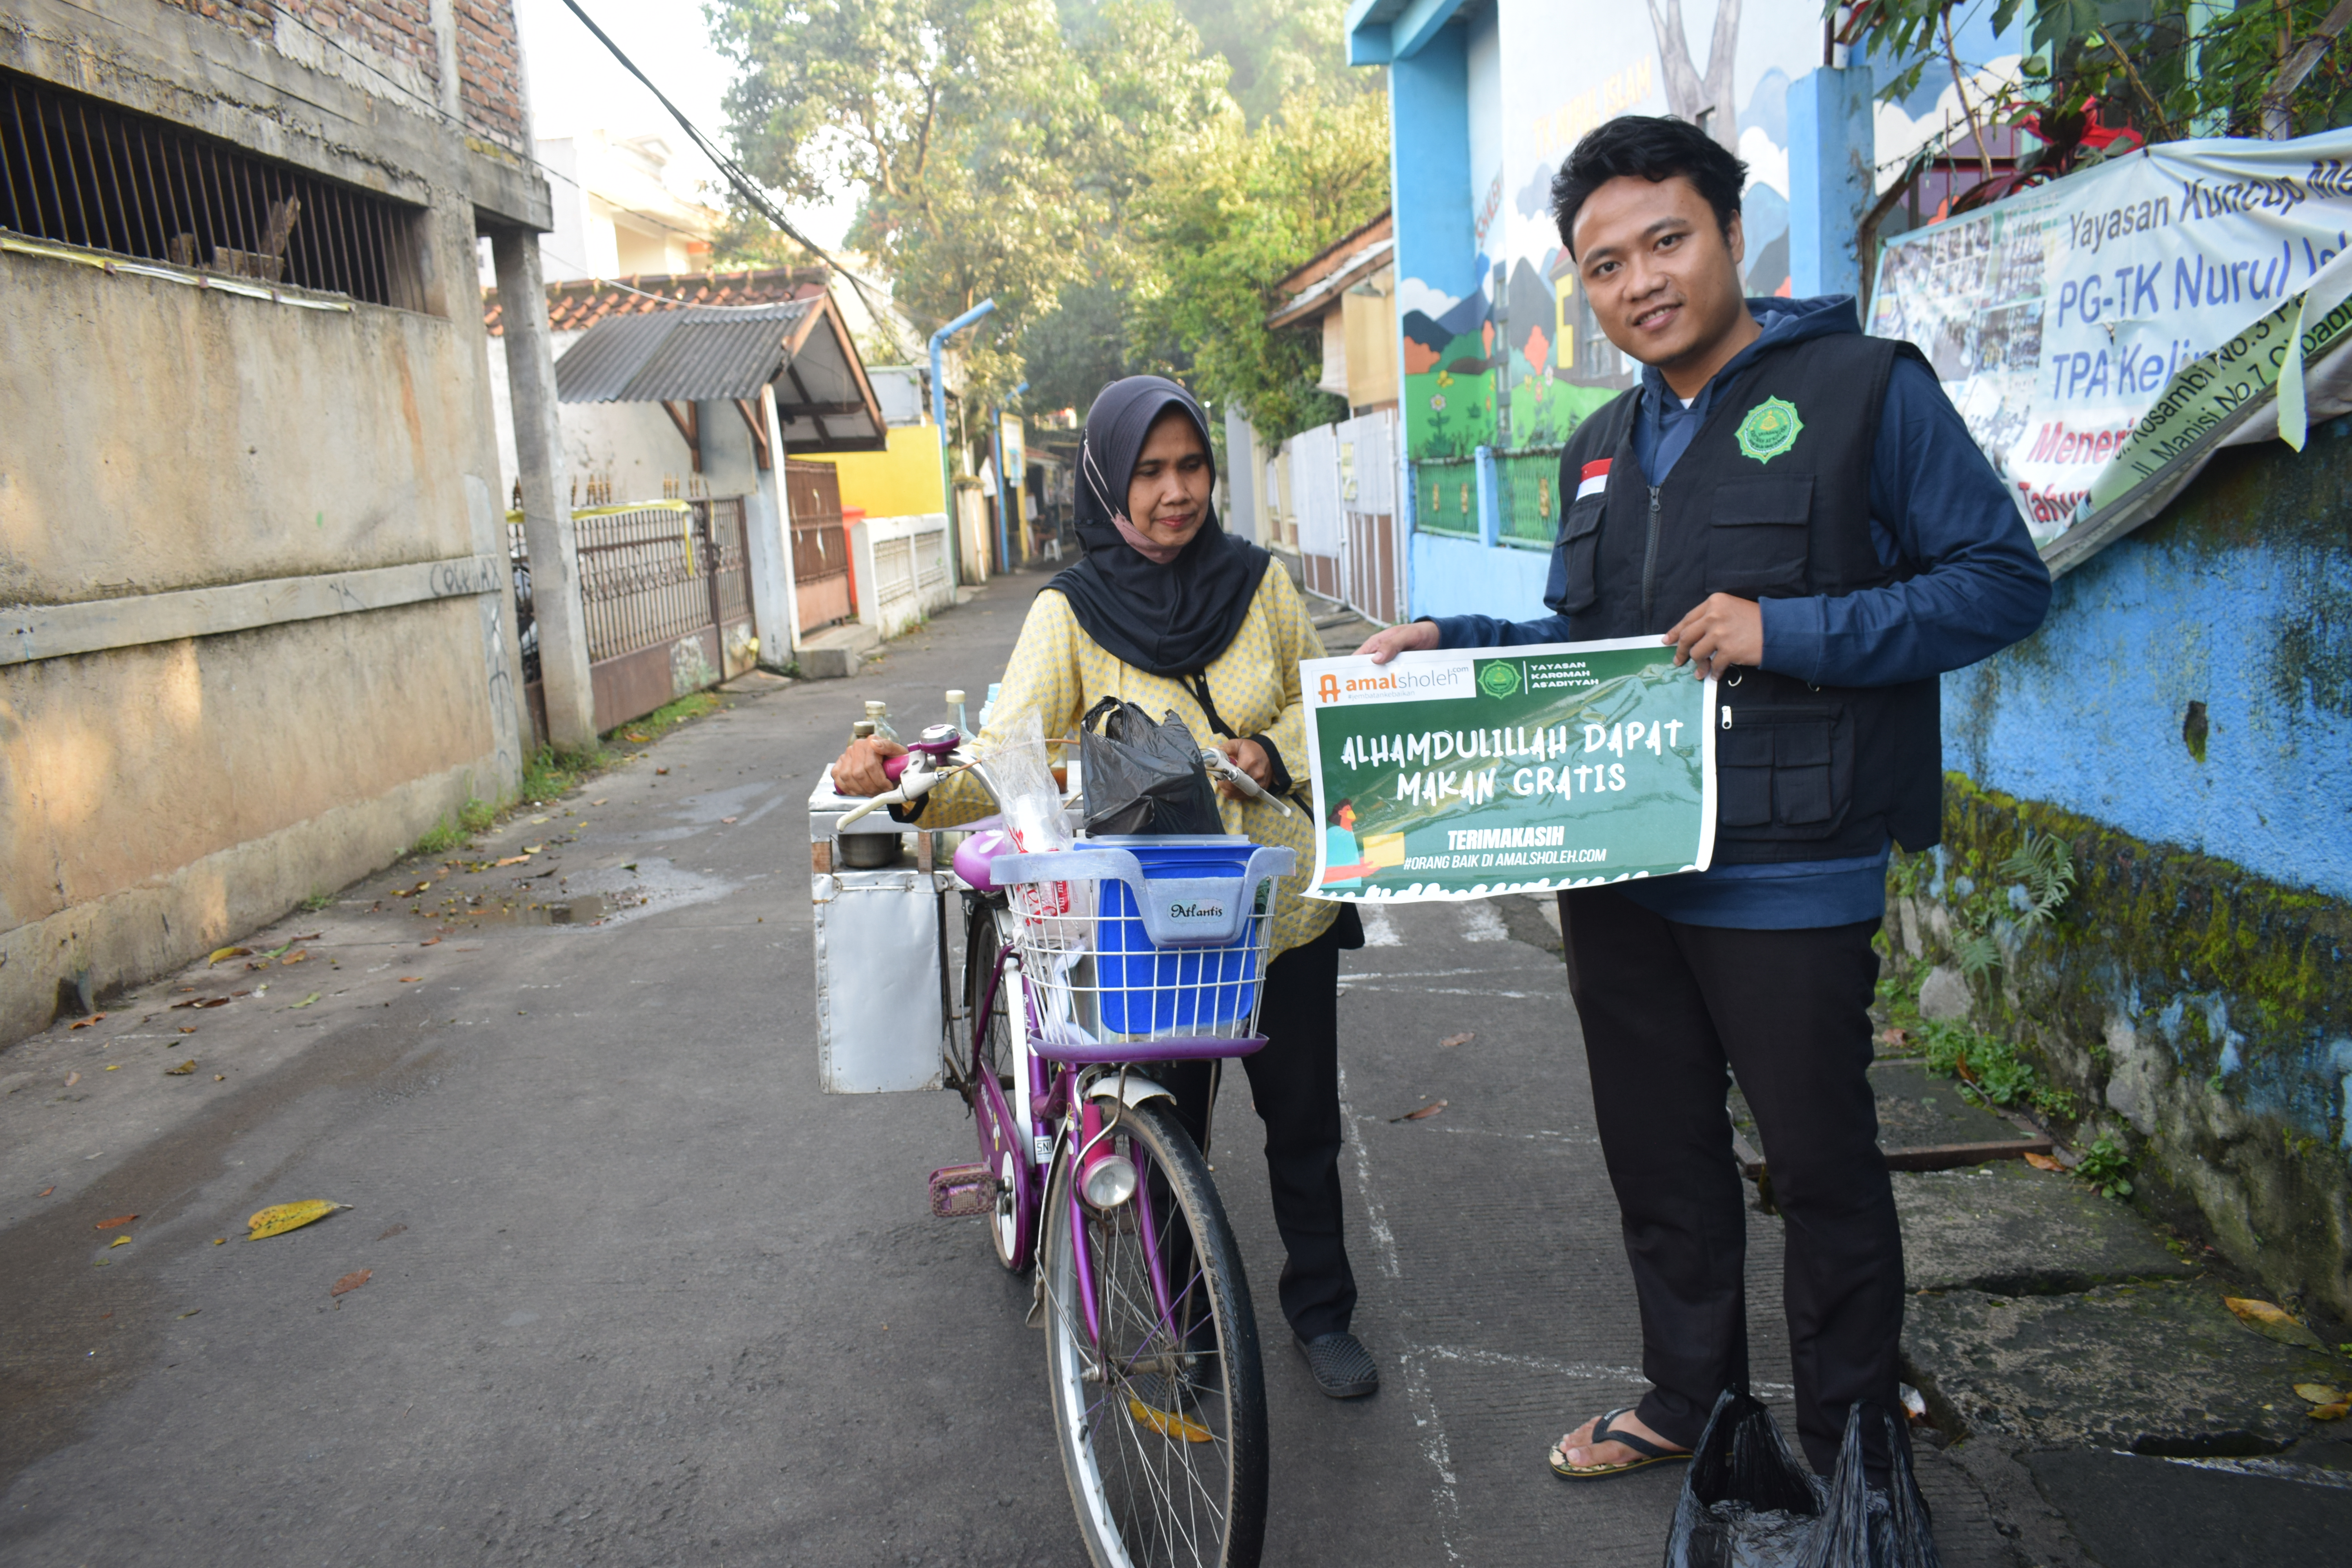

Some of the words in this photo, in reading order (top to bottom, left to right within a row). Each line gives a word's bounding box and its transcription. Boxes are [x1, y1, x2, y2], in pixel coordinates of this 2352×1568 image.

[1533, 114, 1553, 160] TK
[1604, 54, 1651, 123] ISLAM
[2070, 196, 2169, 254] Yayasan
[2179, 176, 2305, 222] Kuncup
[2058, 261, 2162, 328] PG-TK
[2174, 240, 2291, 310] Nurul
[2053, 348, 2109, 400] TPA
[1530, 662, 1586, 671] YAYASAN
[1531, 670, 1590, 679] KAROMAH
[1532, 679, 1599, 688] AS'ADIYYAH
[1348, 690, 1415, 701] #jembatankebaikan
[1341, 726, 1566, 771] ALHAMDULILLAH
[1583, 719, 1683, 758] DAPAT
[1397, 768, 1497, 806] MAKAN
[1513, 763, 1626, 800] GRATIS
[1448, 826, 1564, 850] TERIMAKASIH
[1403, 855, 1449, 870] #ORANG
[1452, 854, 1479, 868] BAIK
[1481, 853, 1494, 867] DI
[1495, 848, 1606, 866] AMALSHOLEH.COM
[1171, 904, 1222, 918] Atlantis
[1037, 1142, 1051, 1152] SNI
